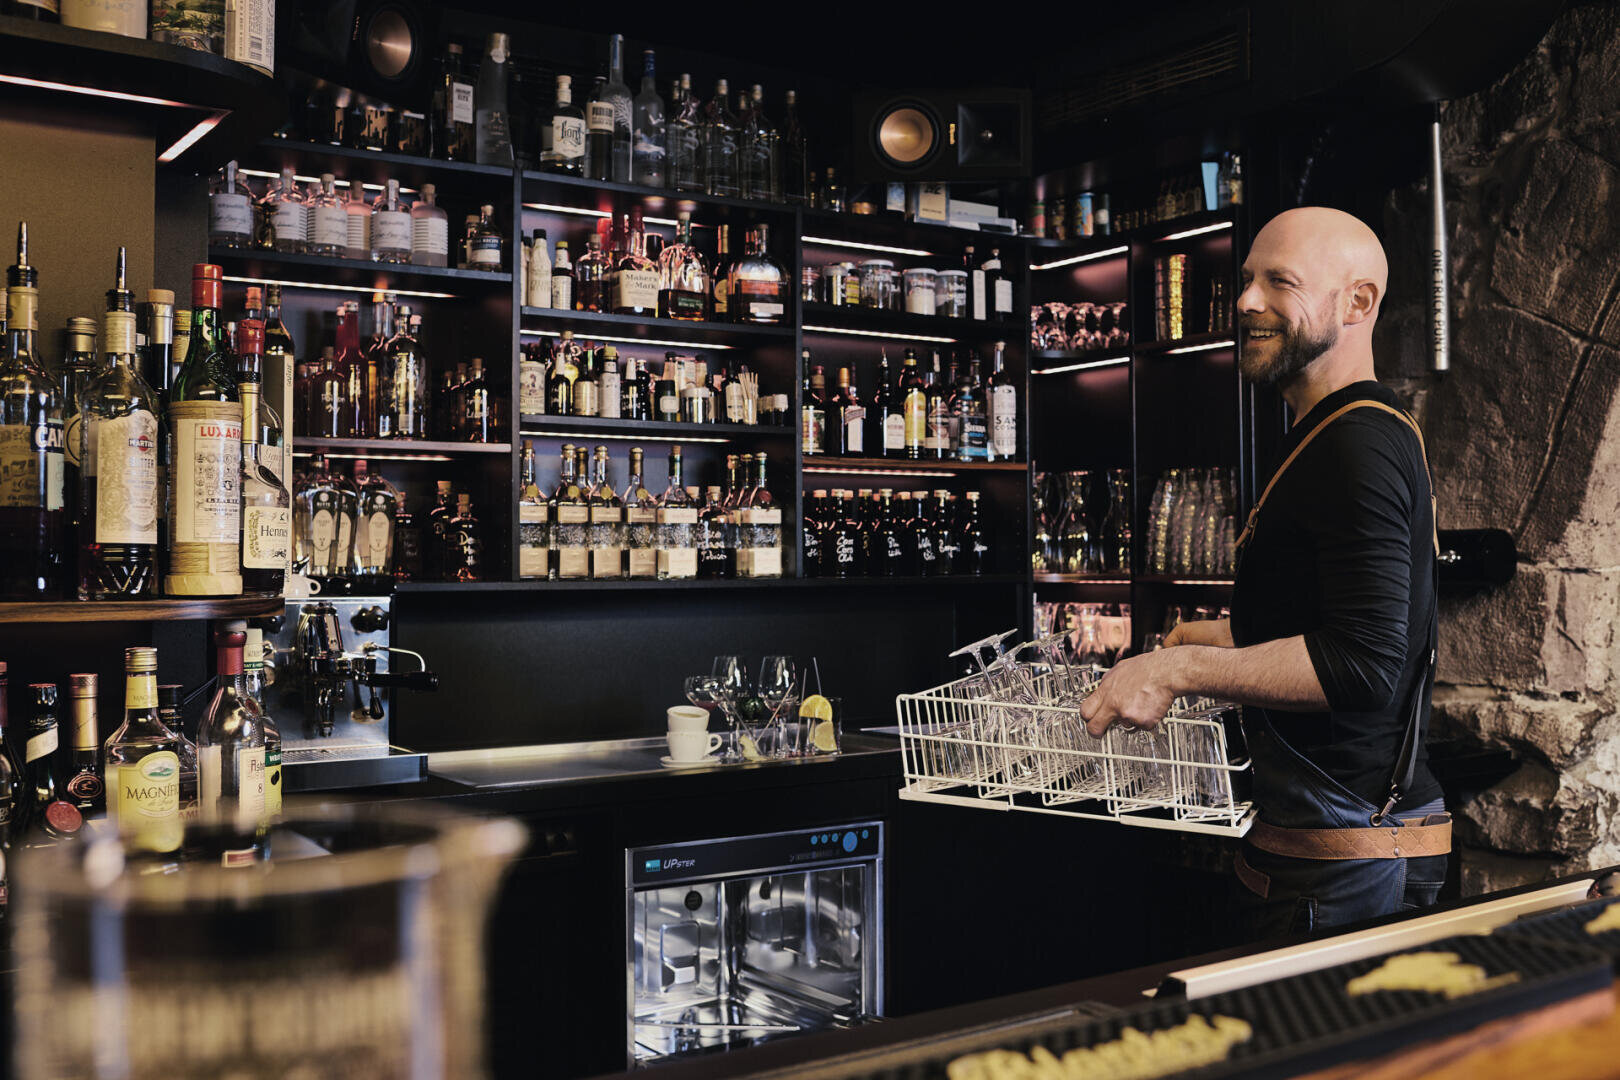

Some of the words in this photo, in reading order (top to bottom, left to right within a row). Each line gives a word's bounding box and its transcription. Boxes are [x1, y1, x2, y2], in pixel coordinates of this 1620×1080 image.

[1432, 249, 1444, 275] ONE
[1433, 279, 1445, 315] TRICK
[257, 783, 263, 793] 8
